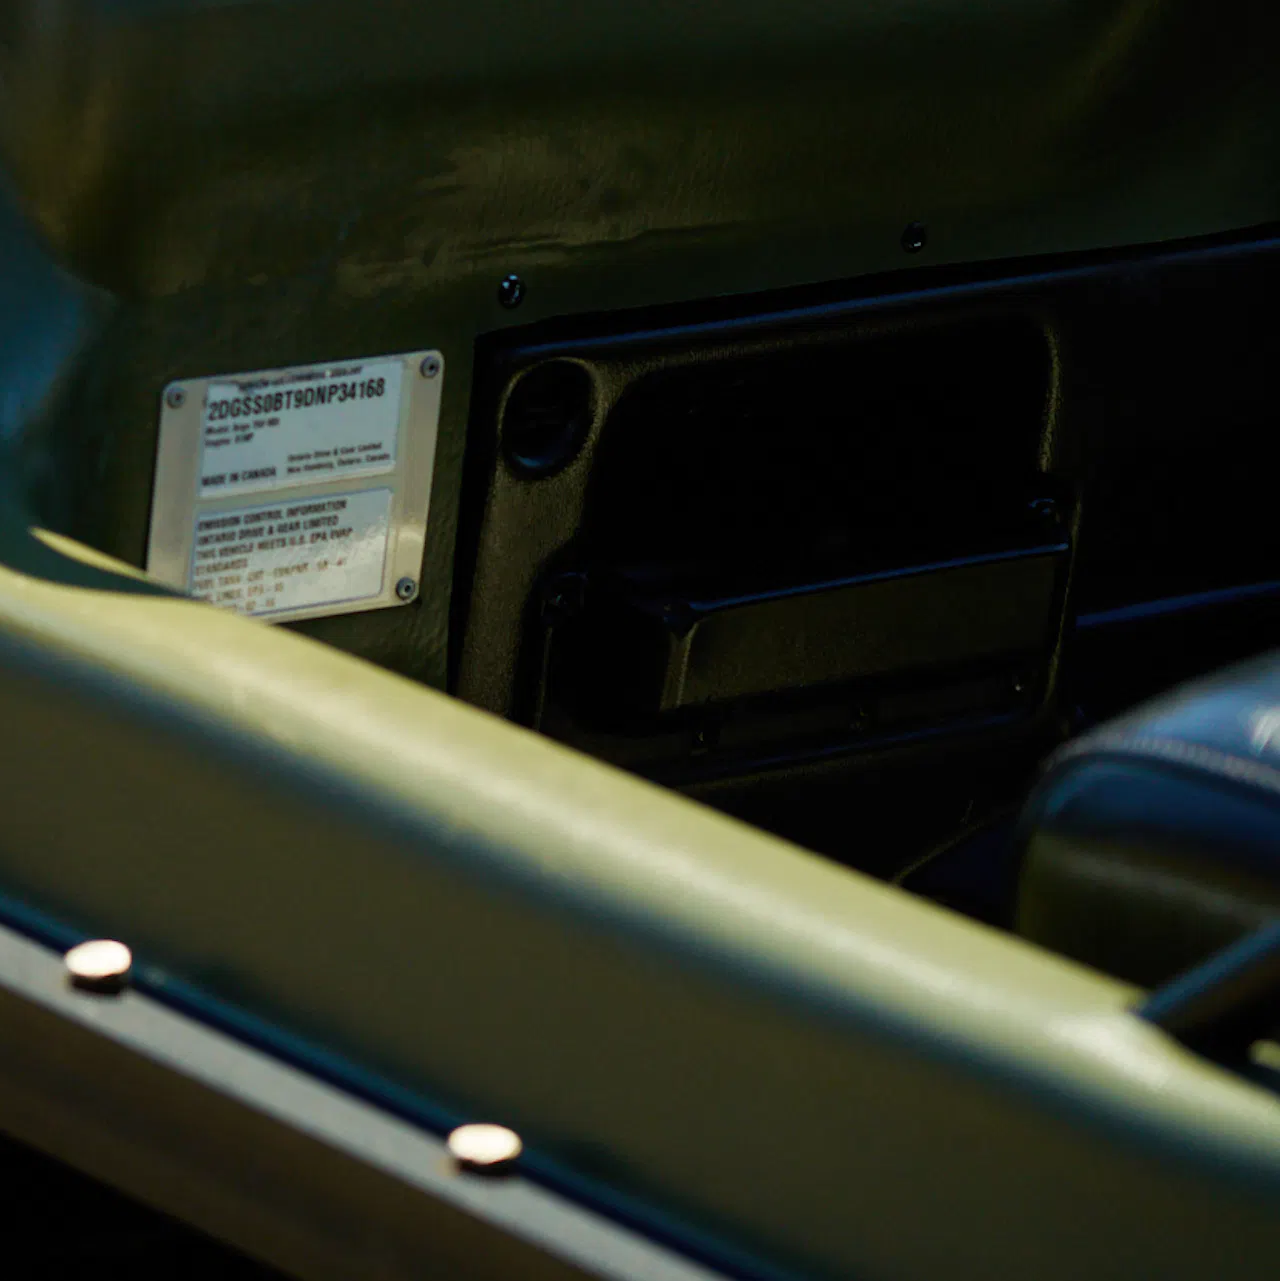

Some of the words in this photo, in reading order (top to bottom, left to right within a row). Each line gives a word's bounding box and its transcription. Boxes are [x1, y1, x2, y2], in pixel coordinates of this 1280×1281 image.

[208, 377, 386, 421] 2DGSS0BT9DNP34168
[202, 475, 226, 486] MADE
[230, 473, 240, 482] IN
[242, 467, 276, 481] CANADA
[243, 510, 283, 524] CONTROL
[286, 500, 347, 518] INFORMATION
[198, 531, 236, 545] ONTARIO
[238, 526, 264, 541] DRIVE
[277, 521, 300, 534] GEAR
[303, 515, 339, 529] LIMITED
[219, 542, 253, 557] VEHICLE
[257, 537, 286, 551] MEETS
[309, 531, 326, 544] EPA
